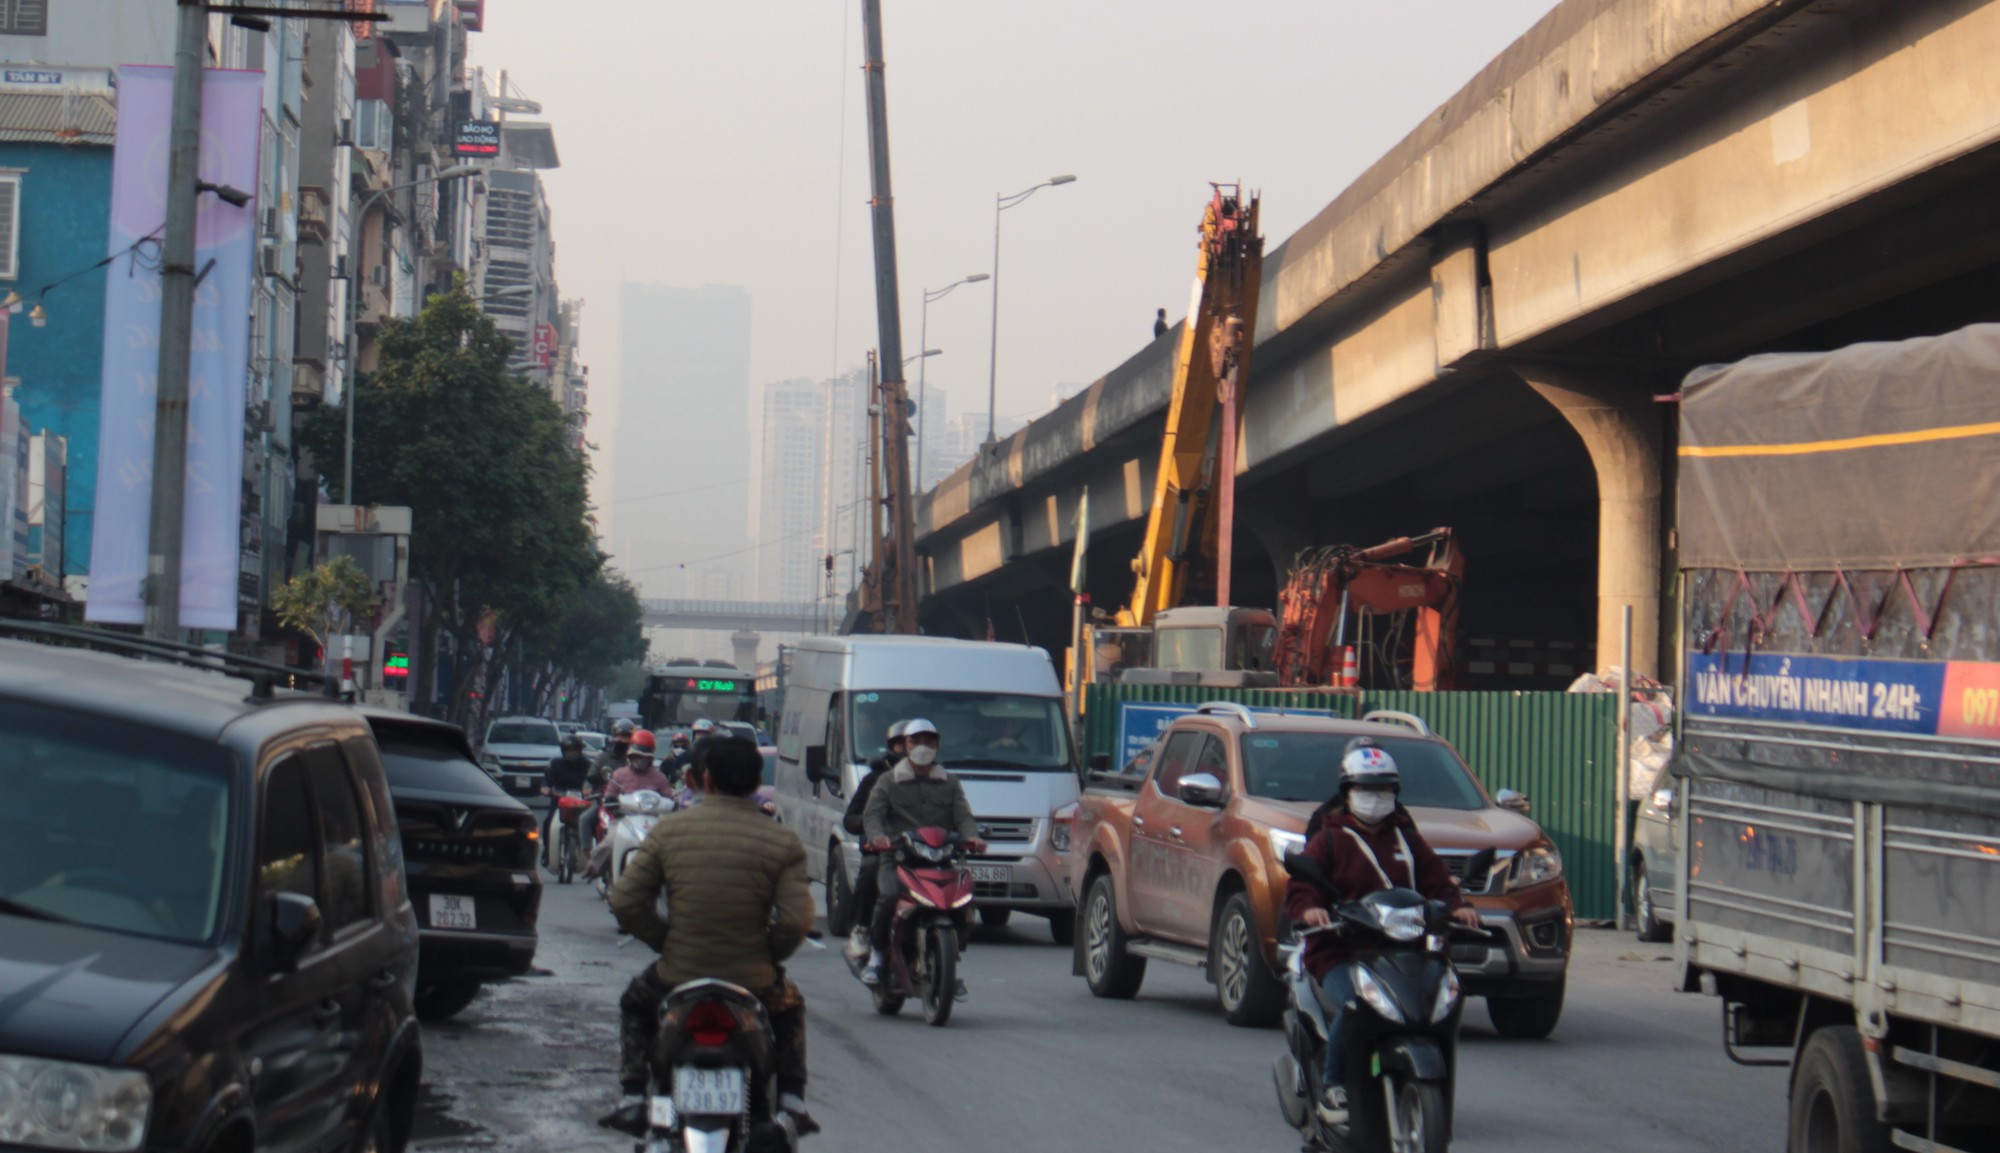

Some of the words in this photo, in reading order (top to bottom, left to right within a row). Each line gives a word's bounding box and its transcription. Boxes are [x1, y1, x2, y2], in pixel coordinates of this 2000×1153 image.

[535, 329, 548, 366] TCL
[1696, 663, 1731, 714] VẬN
[1732, 657, 1801, 711] CHUYỂN
[1804, 677, 1868, 717] NHANH
[1963, 687, 2000, 727] 097
